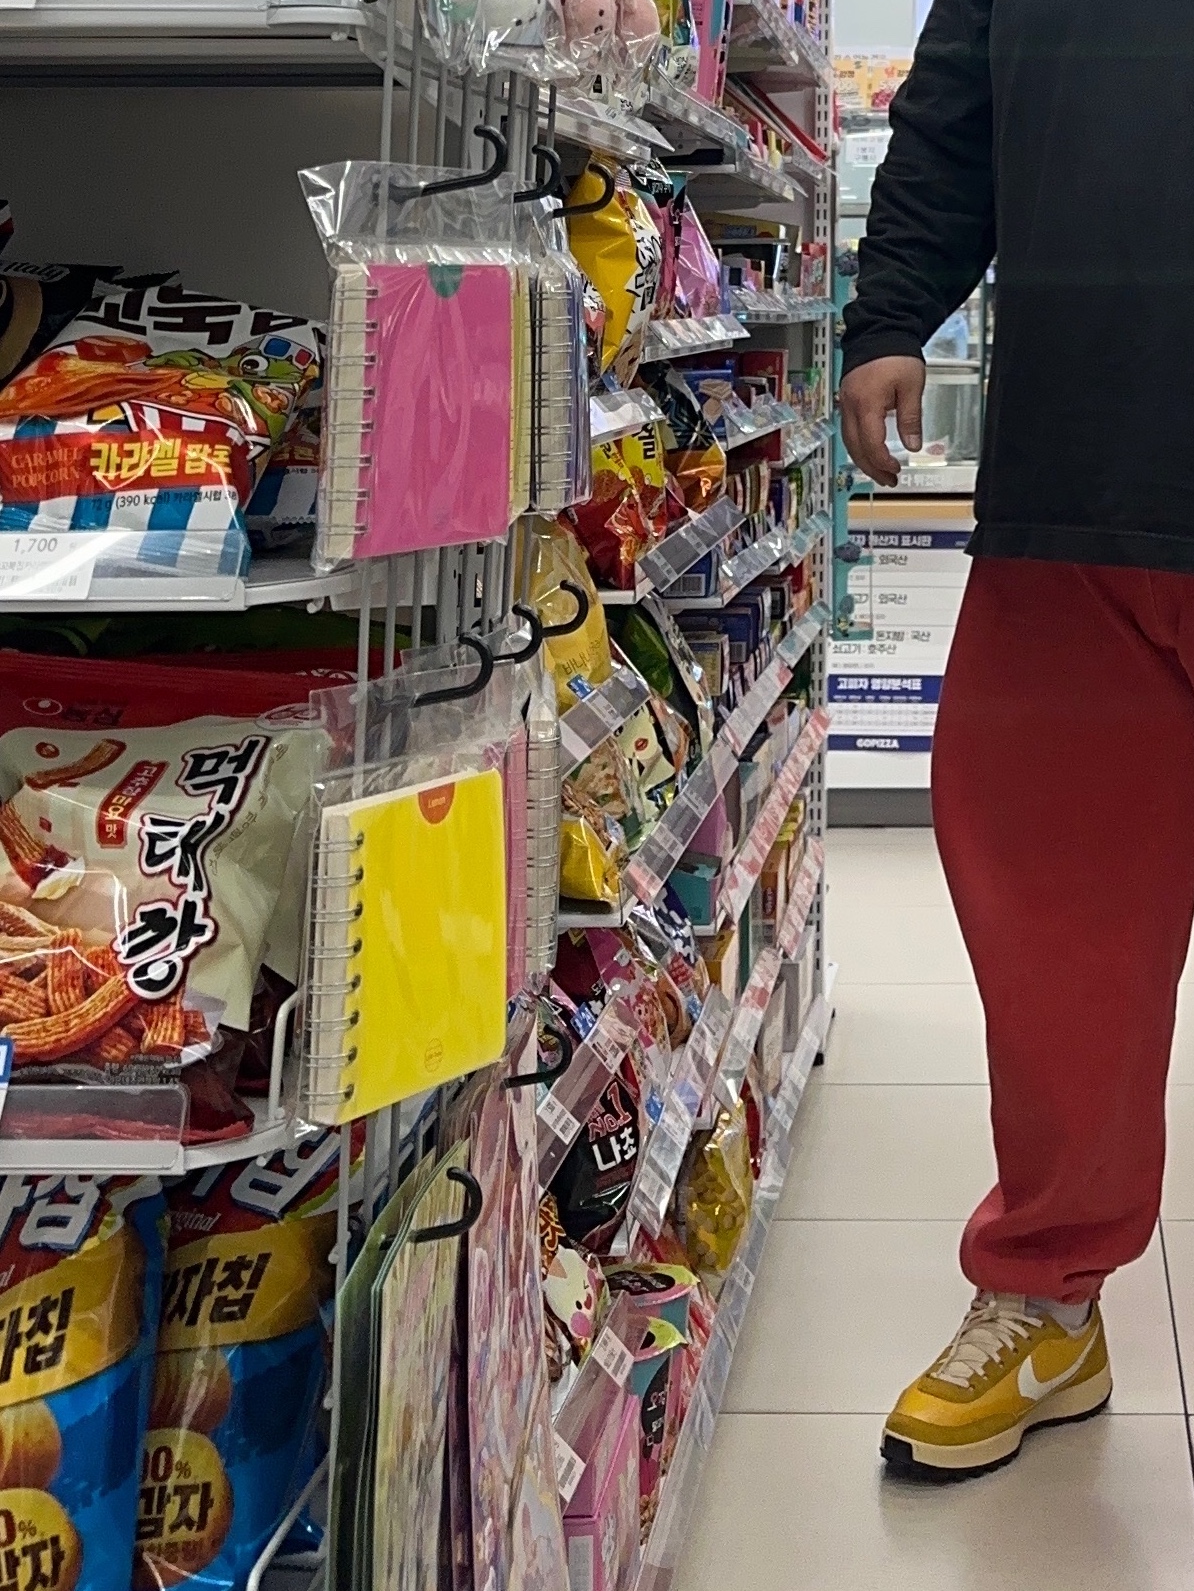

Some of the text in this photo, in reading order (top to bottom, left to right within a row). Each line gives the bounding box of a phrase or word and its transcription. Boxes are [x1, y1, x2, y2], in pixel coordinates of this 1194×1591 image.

[90, 438, 181, 480] 카라멜
[185, 442, 233, 475] 팝콘
[13, 538, 58, 553] 1,700
[856, 738, 900, 749] GOPIZZA
[104, 824, 118, 839] 맛
[120, 738, 262, 996] 먹태깡
[592, 1127, 638, 1172] 나쵸
